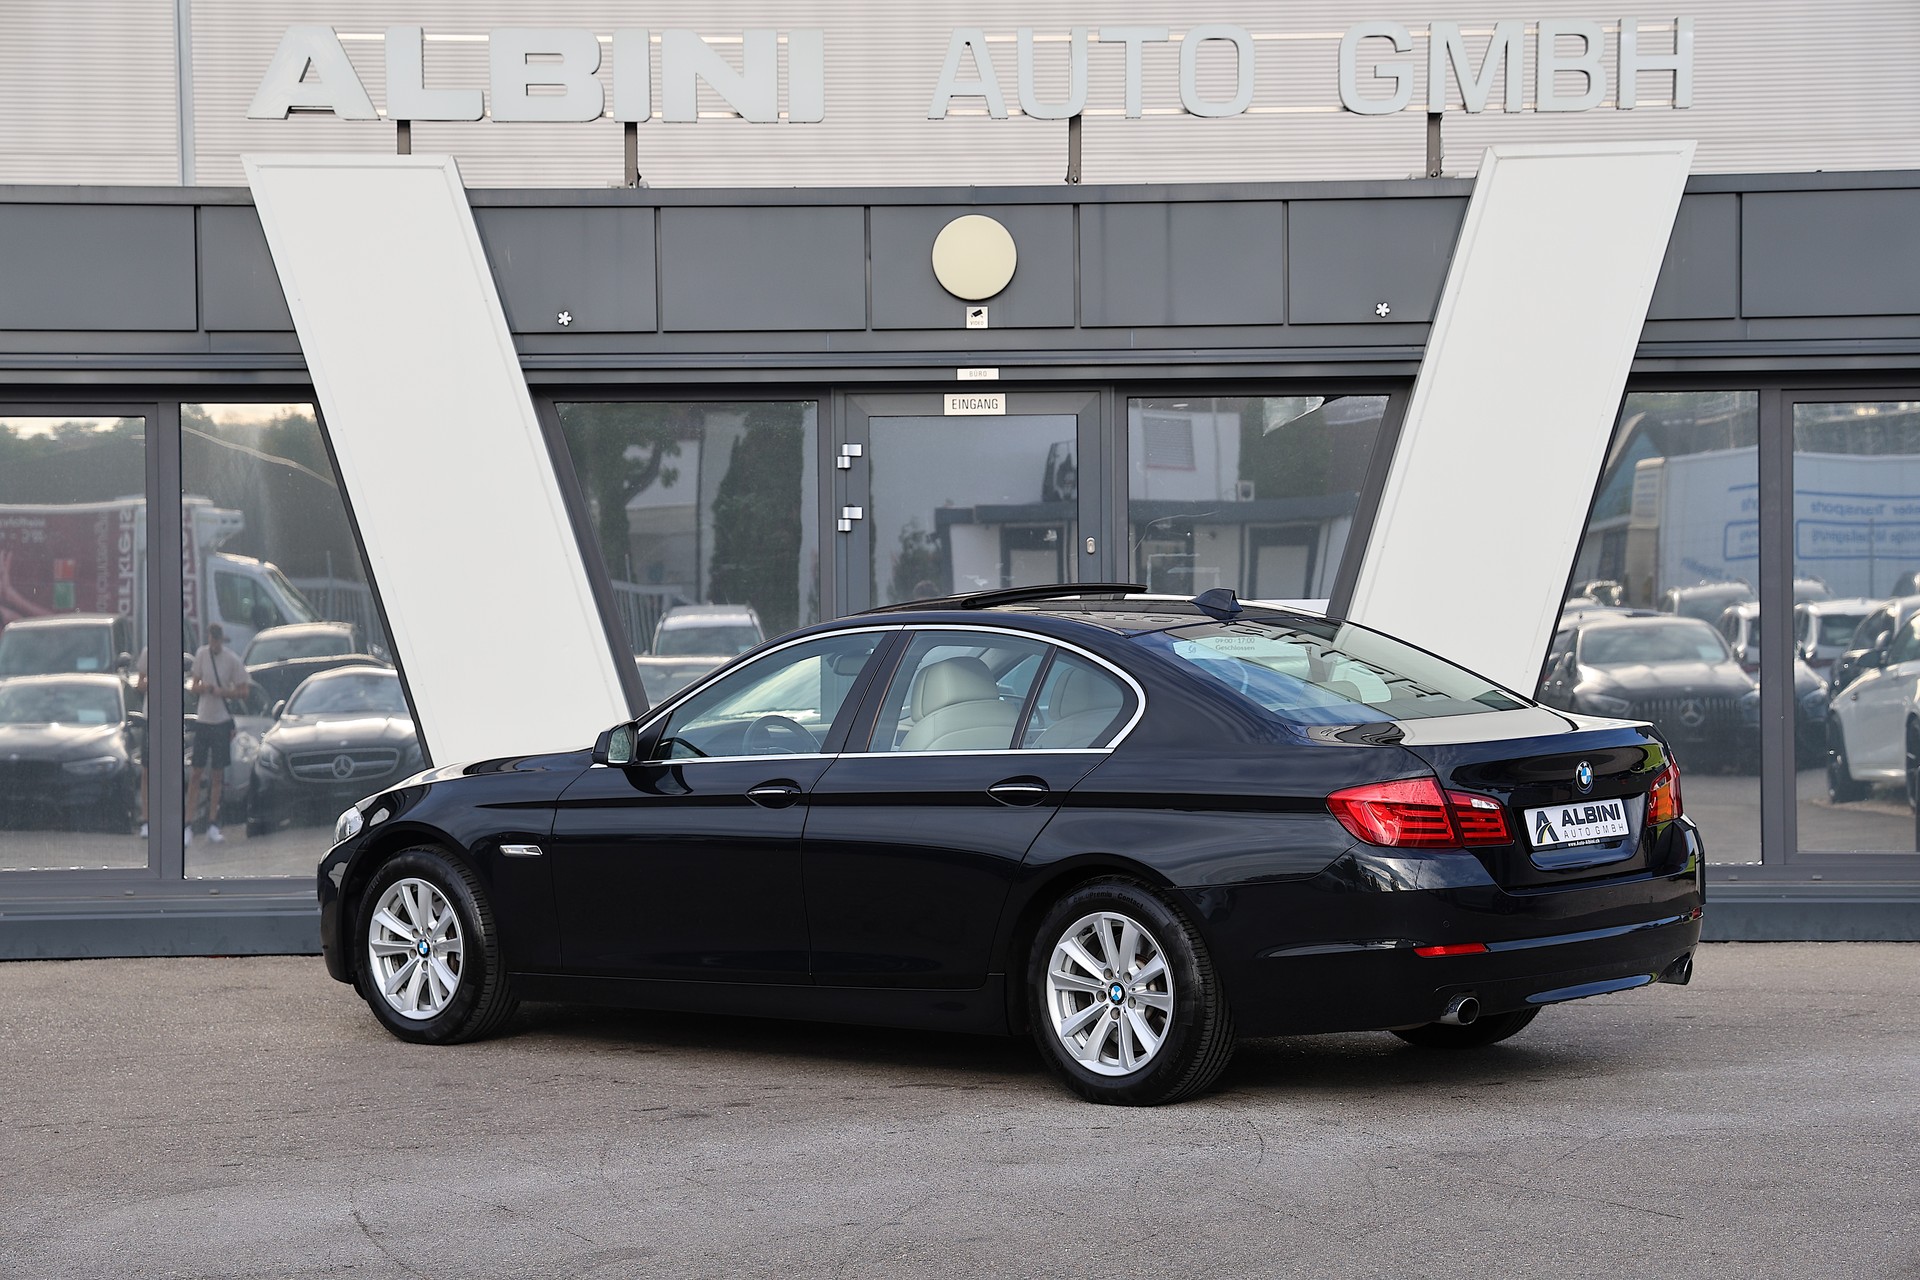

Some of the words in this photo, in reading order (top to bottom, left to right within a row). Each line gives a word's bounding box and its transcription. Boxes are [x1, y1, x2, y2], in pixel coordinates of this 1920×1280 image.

[246, 25, 825, 123] ALBINI
[928, 24, 1255, 119] AUTO
[1338, 16, 1695, 115] GMBH
[969, 370, 988, 378] BÜRO
[952, 398, 999, 410] EINGANG
[1561, 803, 1621, 827] ALBINI
[1564, 826, 1591, 839] AUTO
[1595, 823, 1625, 836] GMBH
